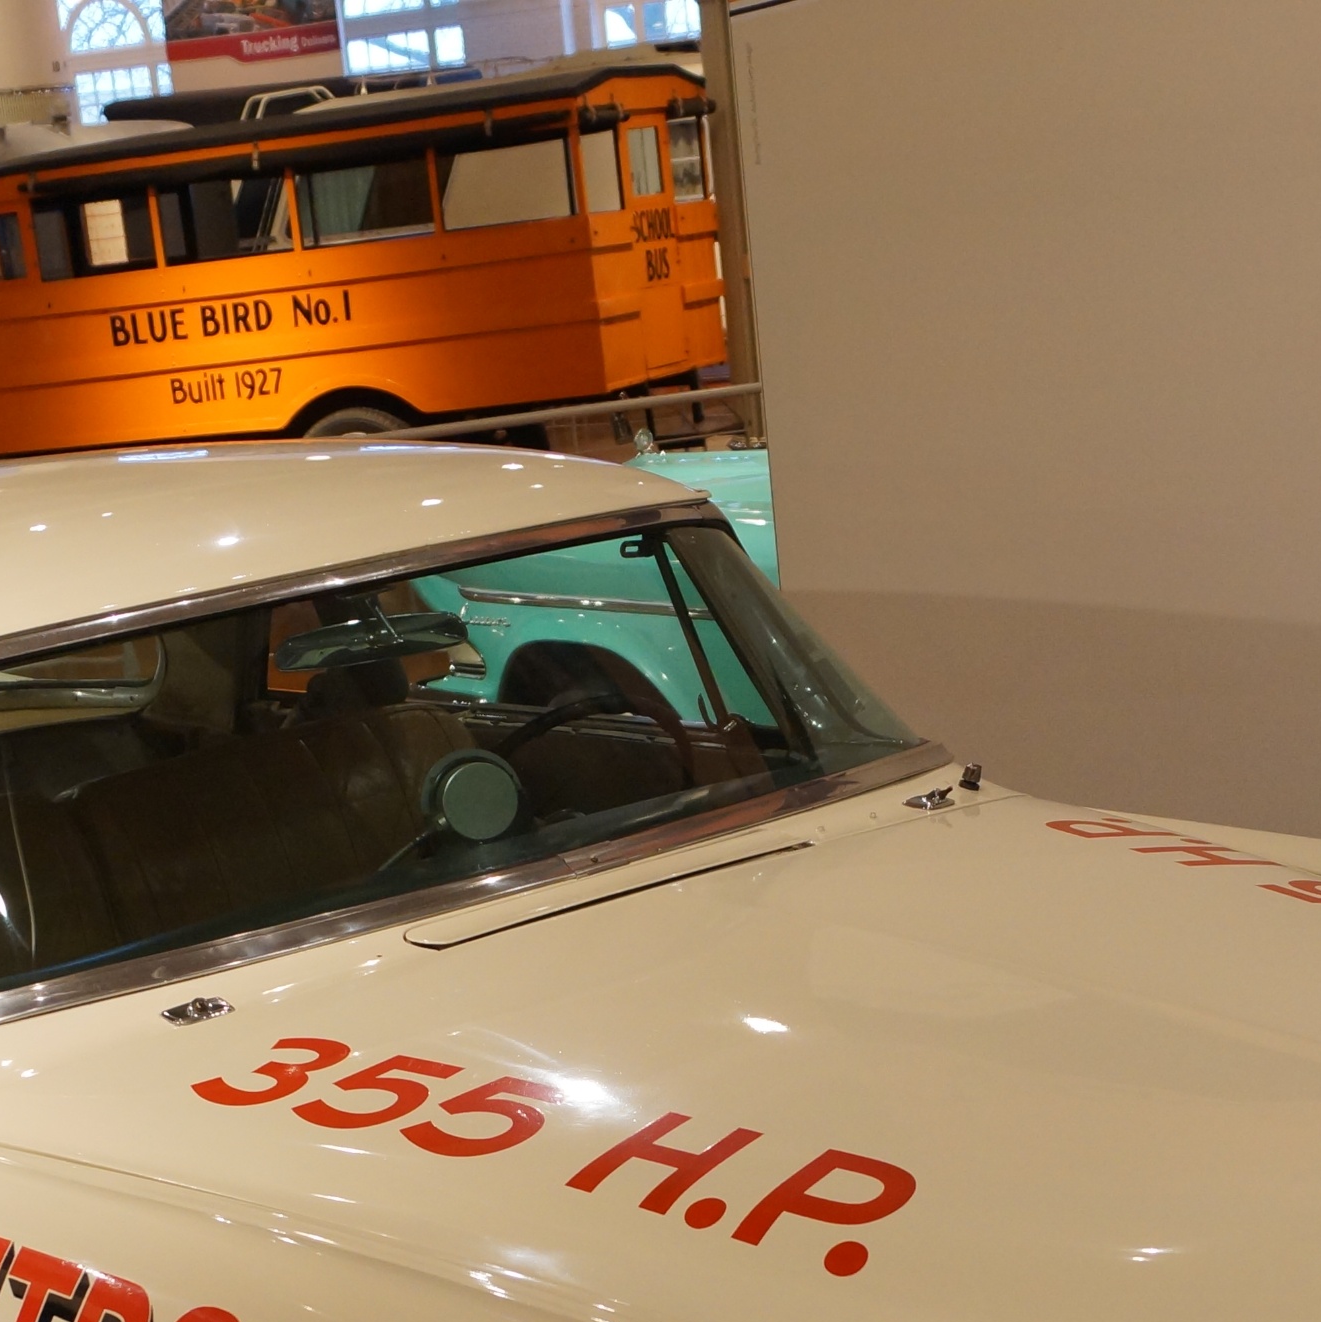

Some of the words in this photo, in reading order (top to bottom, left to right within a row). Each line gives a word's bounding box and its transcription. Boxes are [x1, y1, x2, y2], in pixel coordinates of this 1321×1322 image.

[241, 35, 299, 55] Trucking
[631, 207, 676, 243] SCHOOL
[645, 246, 670, 282] BUS
[109, 308, 189, 347] BLUE
[200, 299, 273, 338] BIRD
[170, 372, 225, 405] Built
[235, 366, 283, 401] 1927
[190, 1037, 567, 1158] 355
[565, 1112, 917, 1277] H.P.
